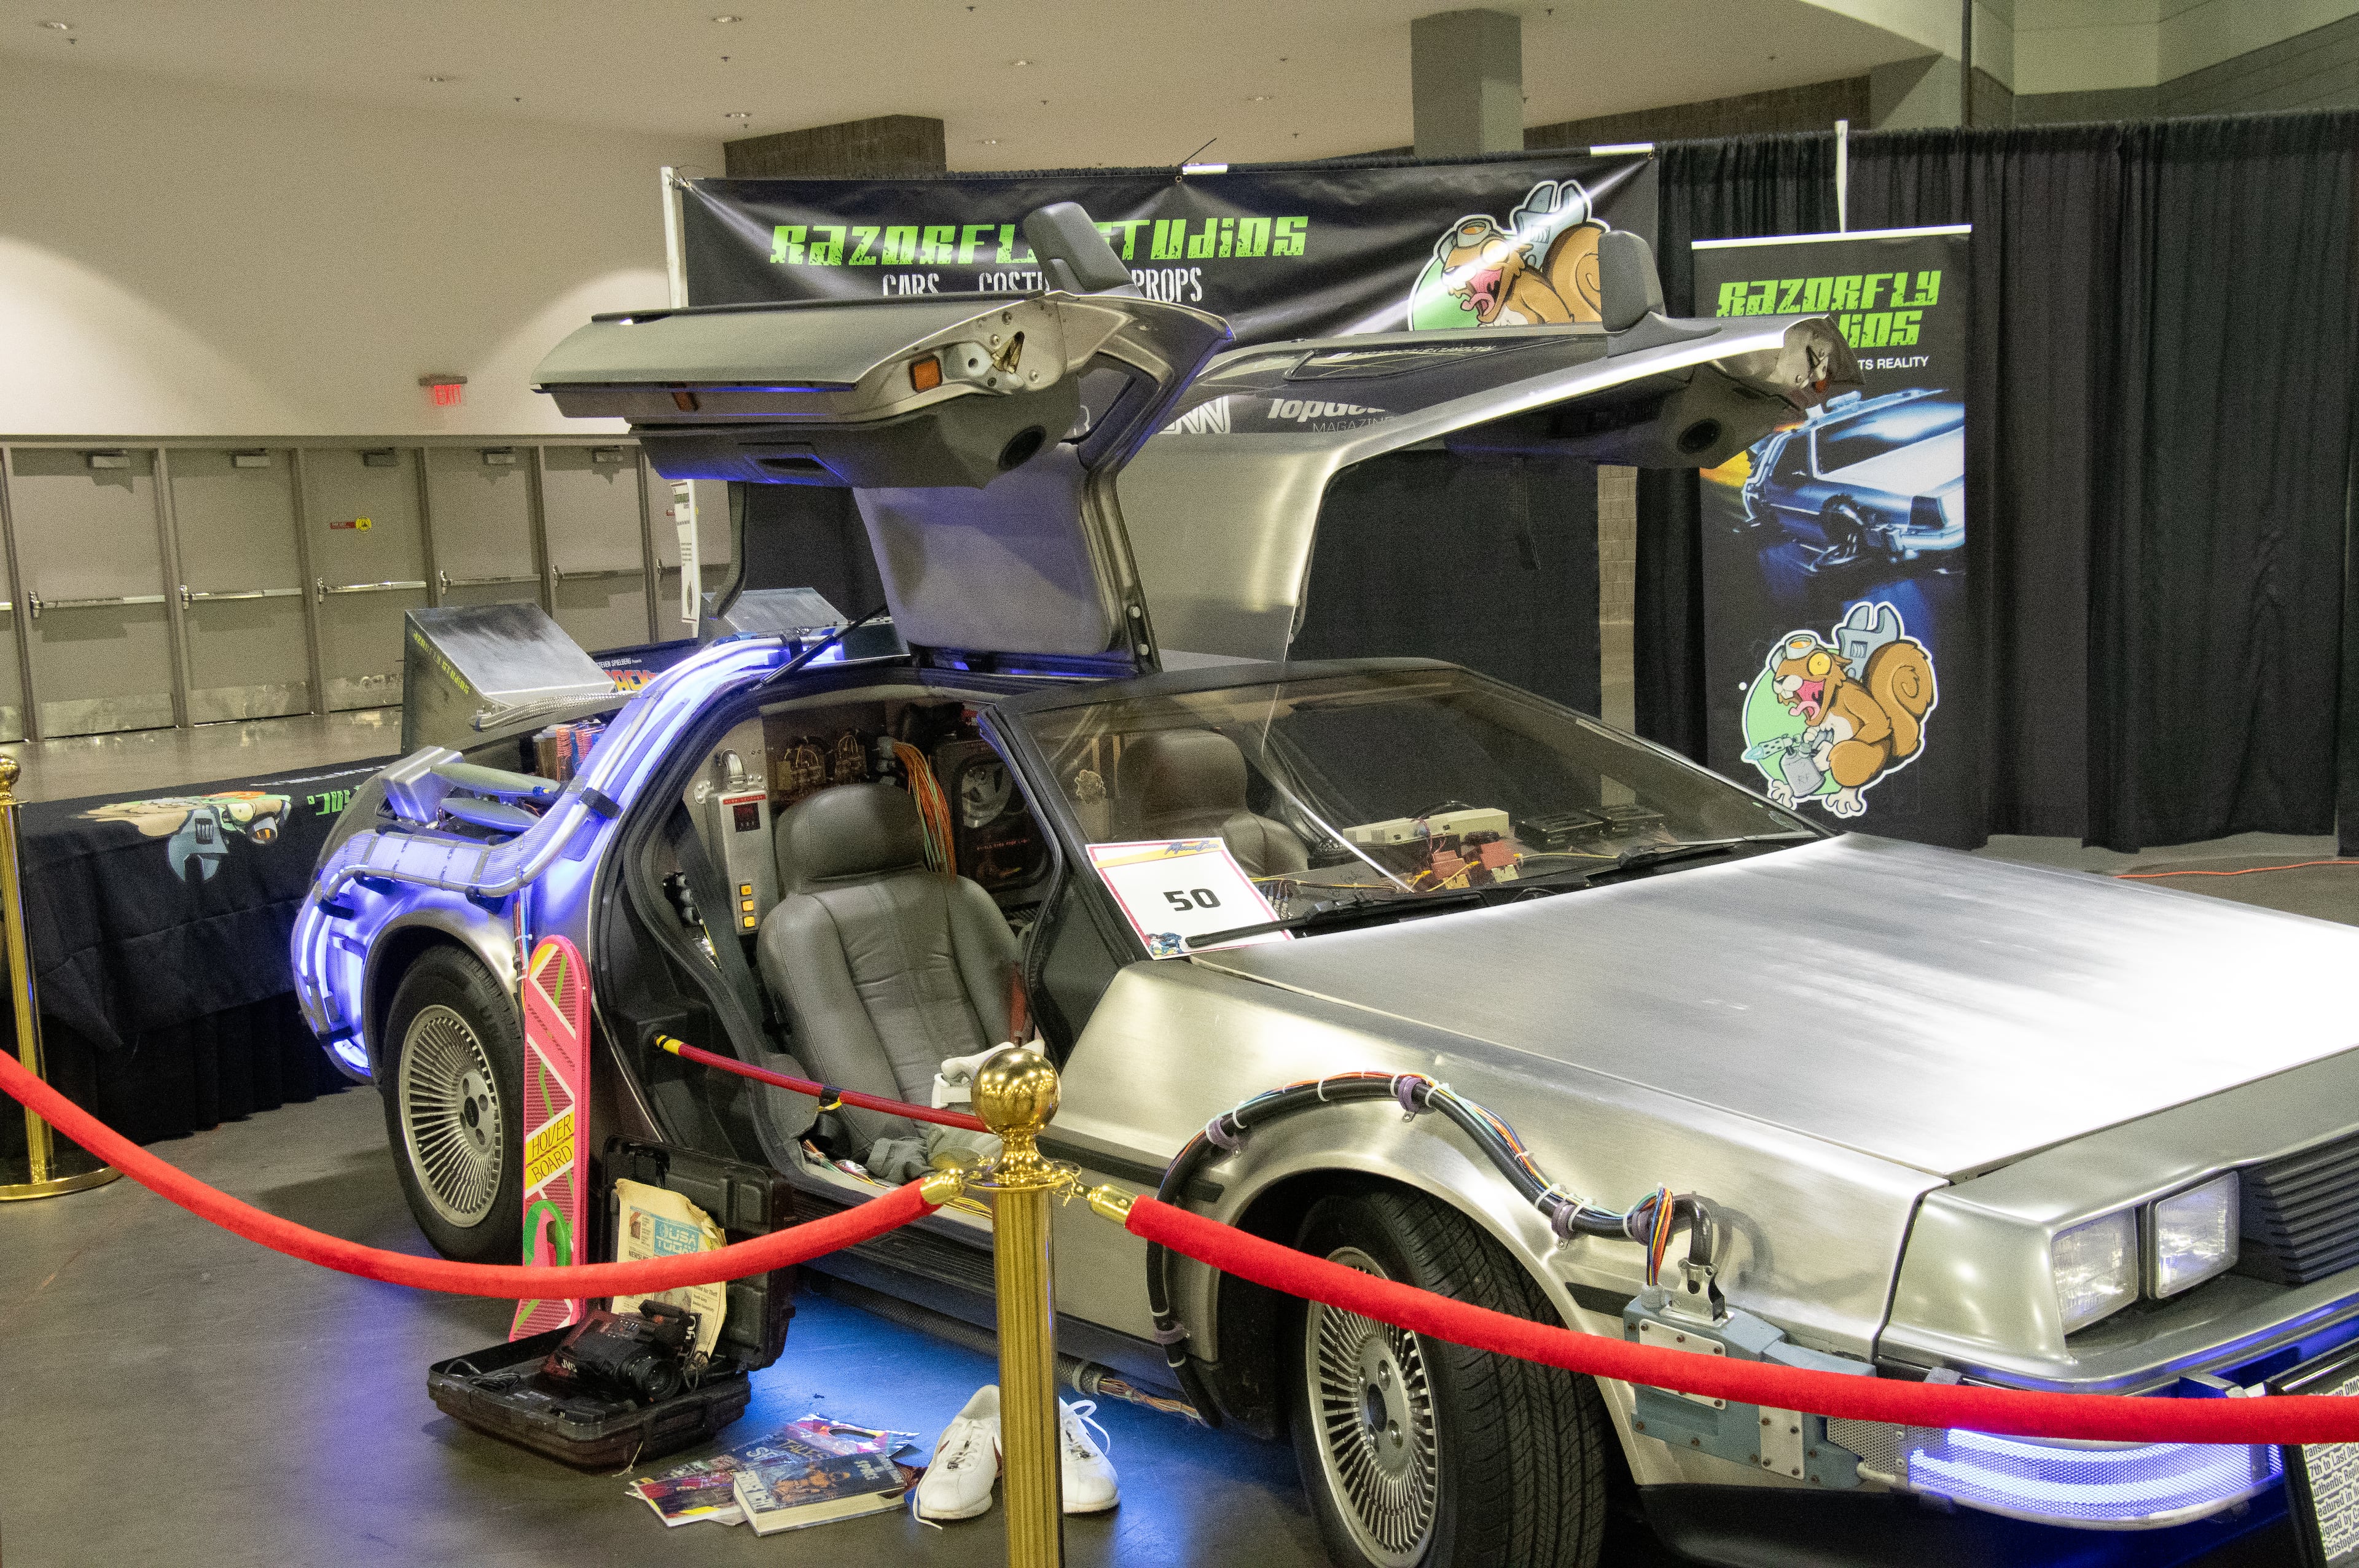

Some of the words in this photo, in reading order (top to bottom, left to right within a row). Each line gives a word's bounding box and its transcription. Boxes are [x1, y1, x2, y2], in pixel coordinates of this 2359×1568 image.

[770, 225, 1038, 266] RAZORFL
[883, 273, 939, 295] CARS
[979, 271, 1050, 292] COSTU
[1131, 267, 1202, 302] PROPS
[1877, 355, 1930, 370] REALITY
[434, 383, 461, 406] EXIT
[611, 658, 632, 667] SPIELBERG
[604, 669, 649, 691] ACK
[1163, 888, 1221, 911] 50
[531, 1115, 573, 1157] HOVER
[531, 1144, 573, 1184] BOARD
[669, 1227, 696, 1247] USA
[561, 1359, 578, 1373] JVC
[2323, 1459, 2331, 1472] to
[2331, 1449, 2347, 1467] Last
[2346, 1442, 2359, 1458] DeL
[2312, 1474, 2344, 1498] uthentic
[2343, 1462, 2359, 1482] Repli
[2317, 1493, 2345, 1517] eatured
[2345, 1490, 2353, 1503] in
[2320, 1516, 2342, 1538] igned
[2342, 1513, 2352, 1527] by
[2324, 1528, 2359, 1557] hristophe
